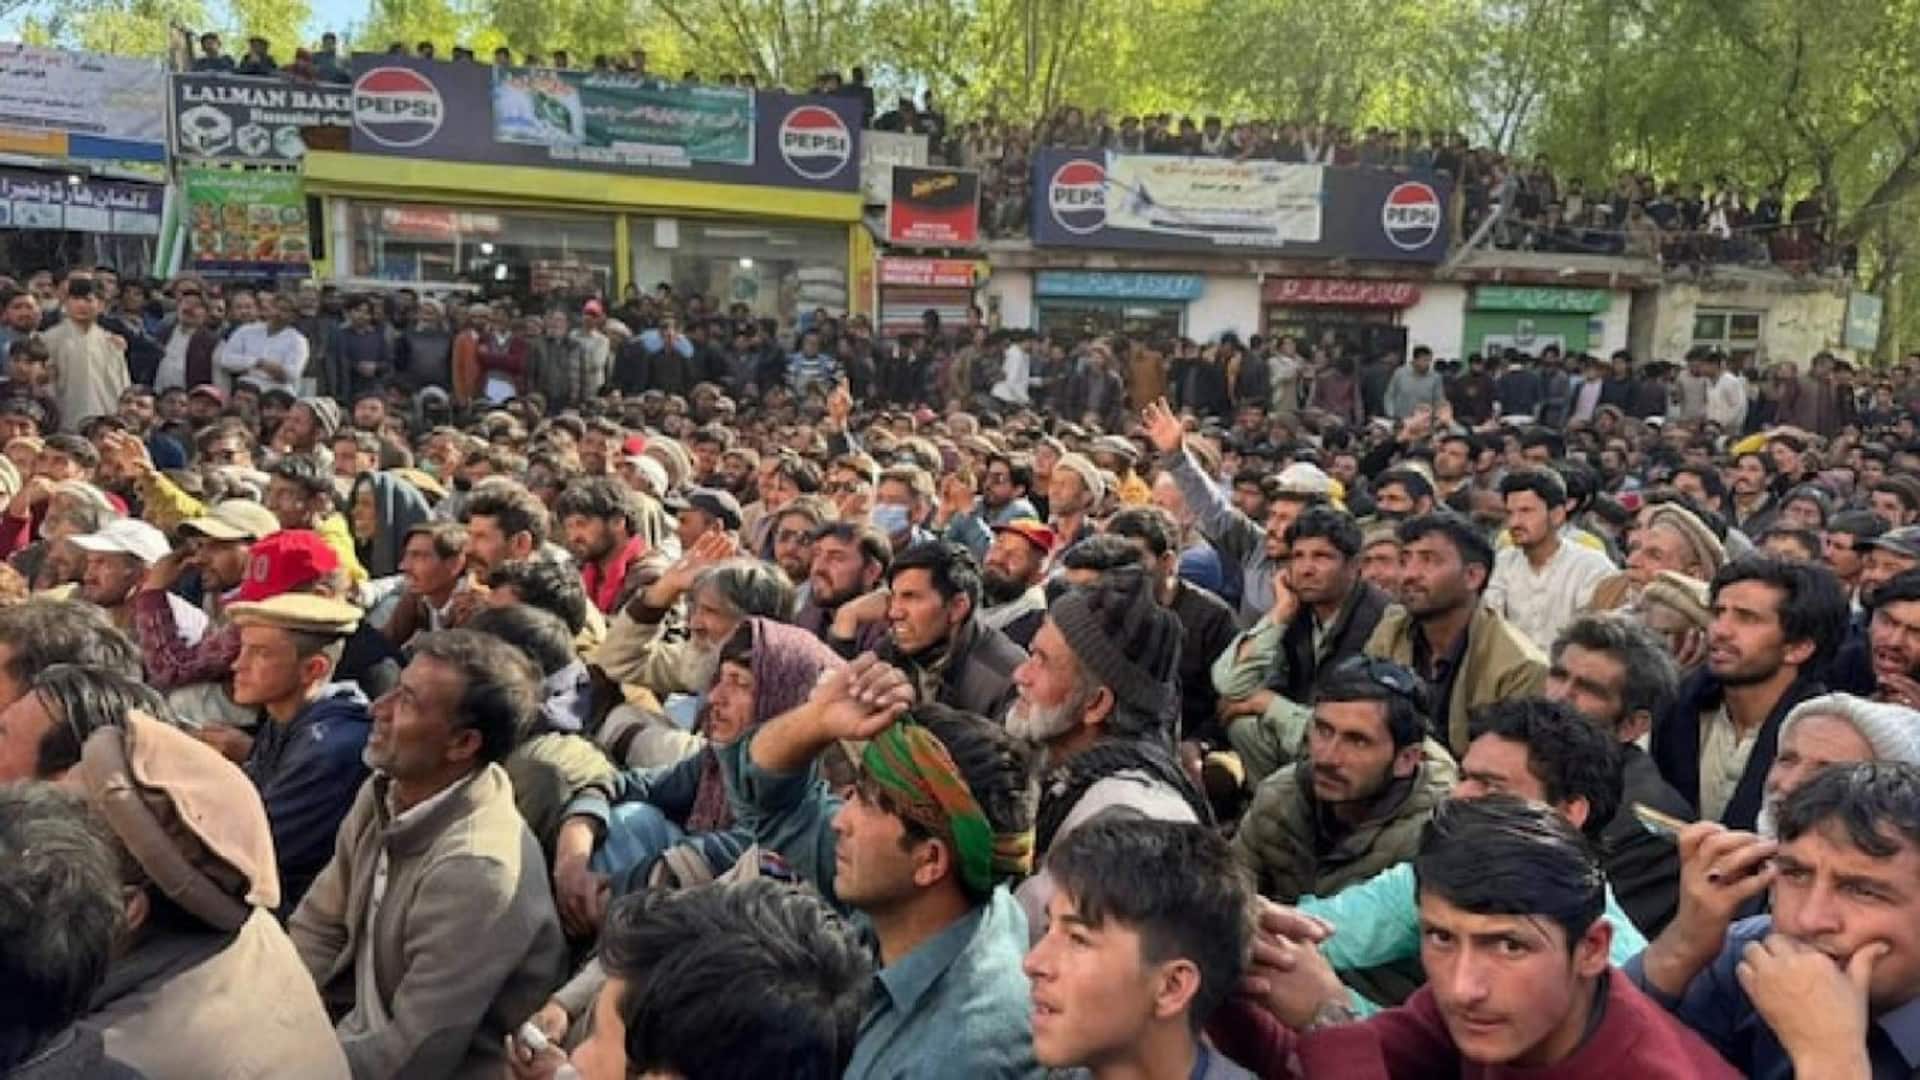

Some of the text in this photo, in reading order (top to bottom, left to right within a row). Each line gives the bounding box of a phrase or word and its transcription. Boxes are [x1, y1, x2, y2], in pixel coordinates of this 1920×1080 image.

[182, 84, 286, 108] LALMAN
[357, 96, 439, 118] PEPSI
[784, 132, 846, 151] PEPSI
[1386, 208, 1436, 223] PEPSI
